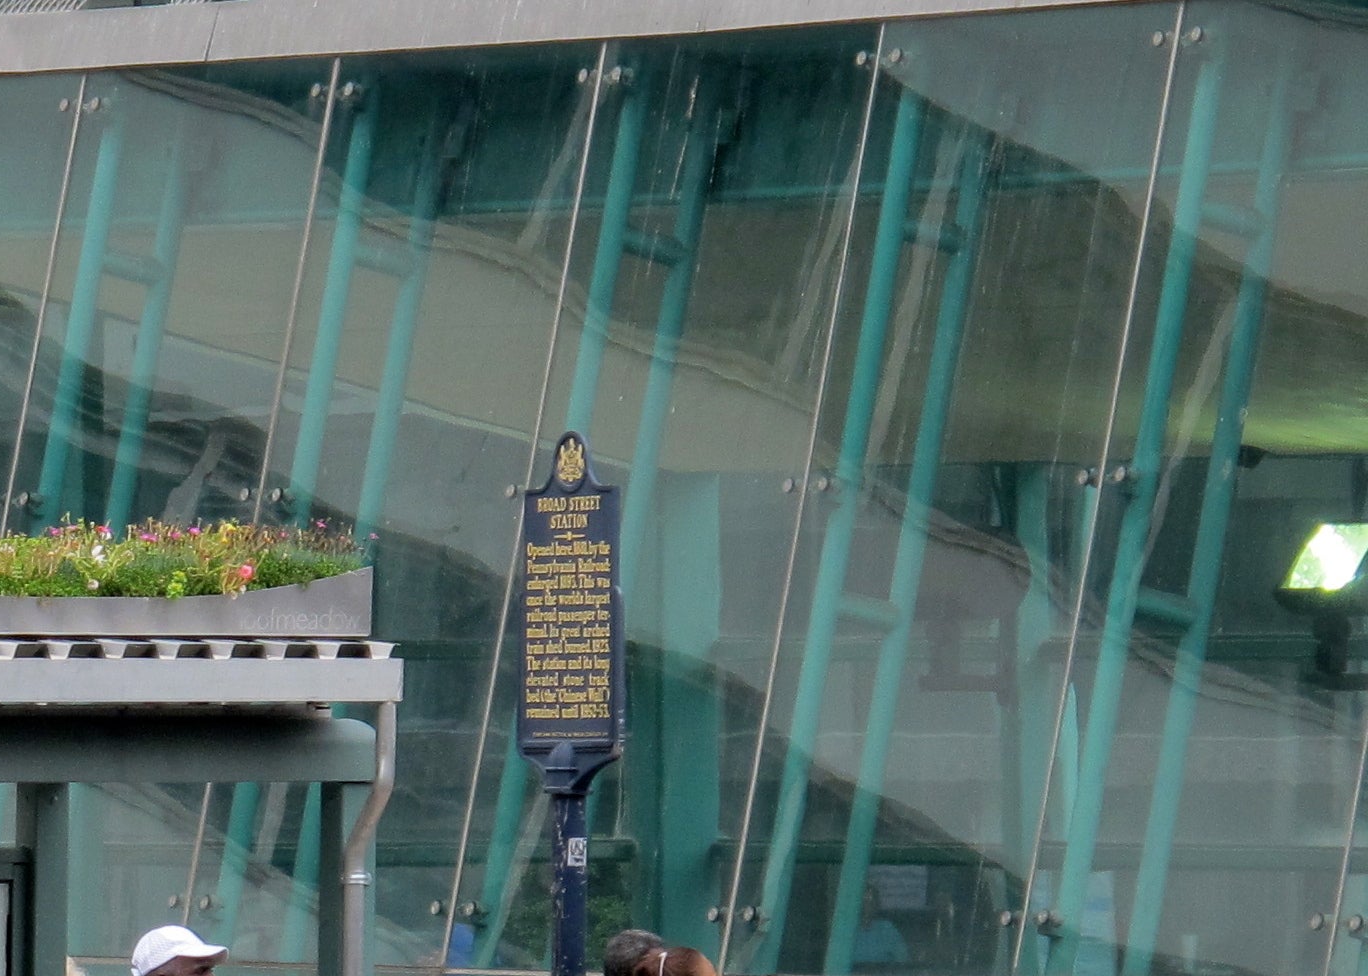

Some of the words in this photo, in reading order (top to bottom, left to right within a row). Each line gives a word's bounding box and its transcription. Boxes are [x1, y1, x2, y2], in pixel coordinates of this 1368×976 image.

[537, 497, 568, 512] BROAD
[569, 495, 601, 511] STREET
[550, 513, 590, 529] STATION
[527, 542, 554, 560] Opened
[599, 540, 611, 554] the
[527, 559, 576, 577] Pennsylvania
[527, 576, 558, 593] enlarged
[578, 574, 595, 588] This
[596, 577, 611, 587] was
[526, 596, 543, 606] once
[544, 591, 557, 605] the
[584, 590, 610, 608] largest
[526, 607, 557, 622] railroad
[558, 610, 596, 625] passenger
[561, 625, 581, 640] great
[583, 623, 611, 637] arched
[527, 640, 544, 654] train
[545, 640, 563, 653] shed
[526, 656, 542, 671] The
[542, 656, 567, 670] station
[567, 656, 582, 669] and
[583, 656, 593, 669] its
[594, 655, 611, 673] long
[526, 672, 559, 686] elevated
[563, 673, 585, 686] stone
[589, 671, 610, 686] track
[526, 688, 540, 703] bed
[526, 704, 559, 719] remained
[561, 704, 579, 718] until
